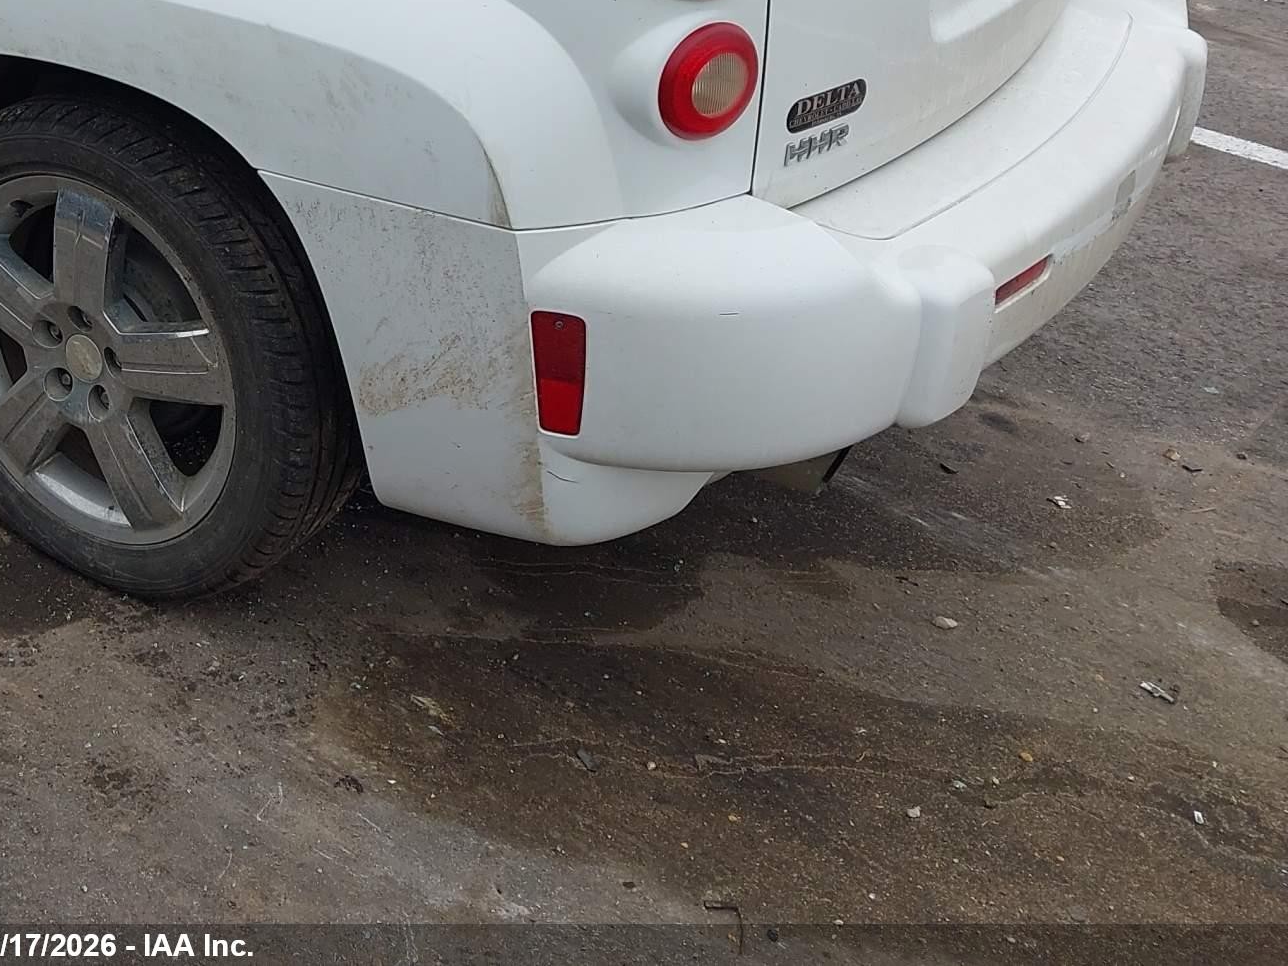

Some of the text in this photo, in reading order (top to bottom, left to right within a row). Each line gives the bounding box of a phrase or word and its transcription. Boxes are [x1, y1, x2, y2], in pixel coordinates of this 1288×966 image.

[795, 82, 861, 116] DELTA
[789, 106, 832, 129] CHEVROLET
[784, 122, 850, 167] HHR
